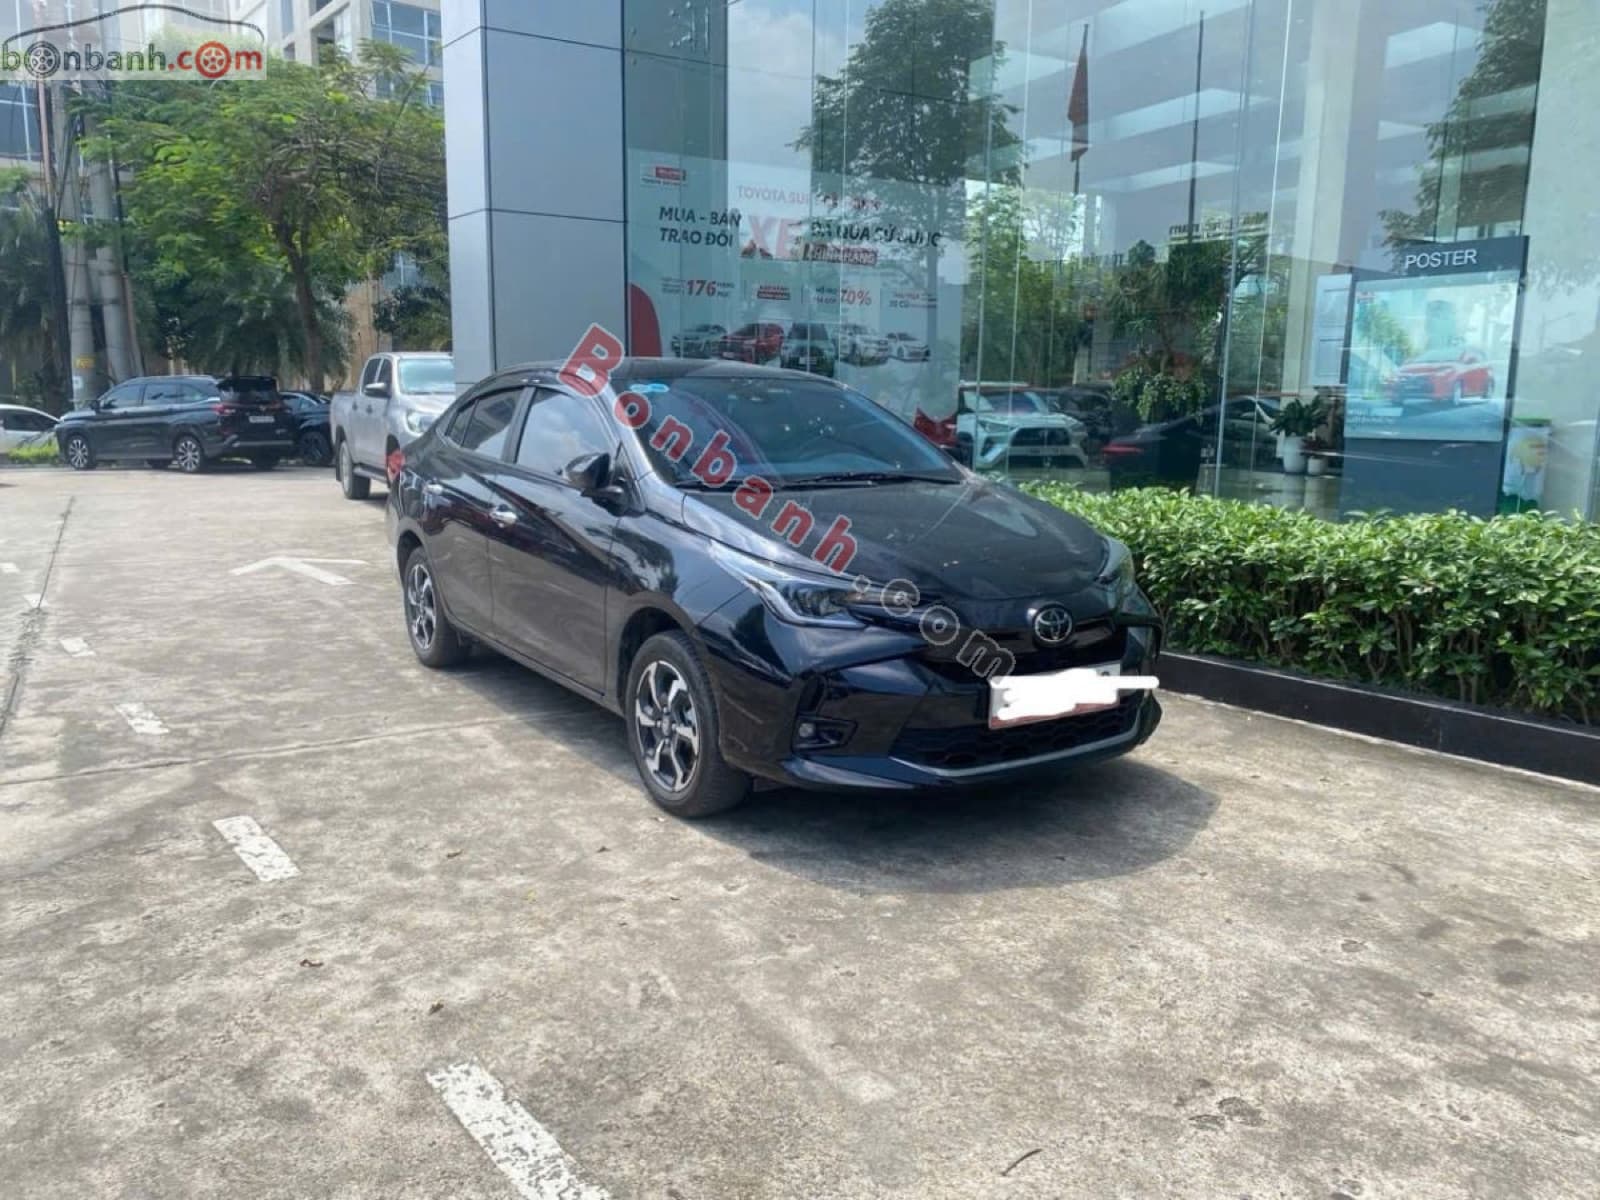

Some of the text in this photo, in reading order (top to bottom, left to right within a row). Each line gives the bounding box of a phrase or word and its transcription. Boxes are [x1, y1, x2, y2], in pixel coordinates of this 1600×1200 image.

[738, 185, 786, 202] TOYOTA
[659, 206, 697, 223] MUA
[660, 227, 702, 245] TRAO
[741, 214, 804, 260] XE
[1404, 248, 1478, 269] POSTER
[686, 279, 717, 297] 176
